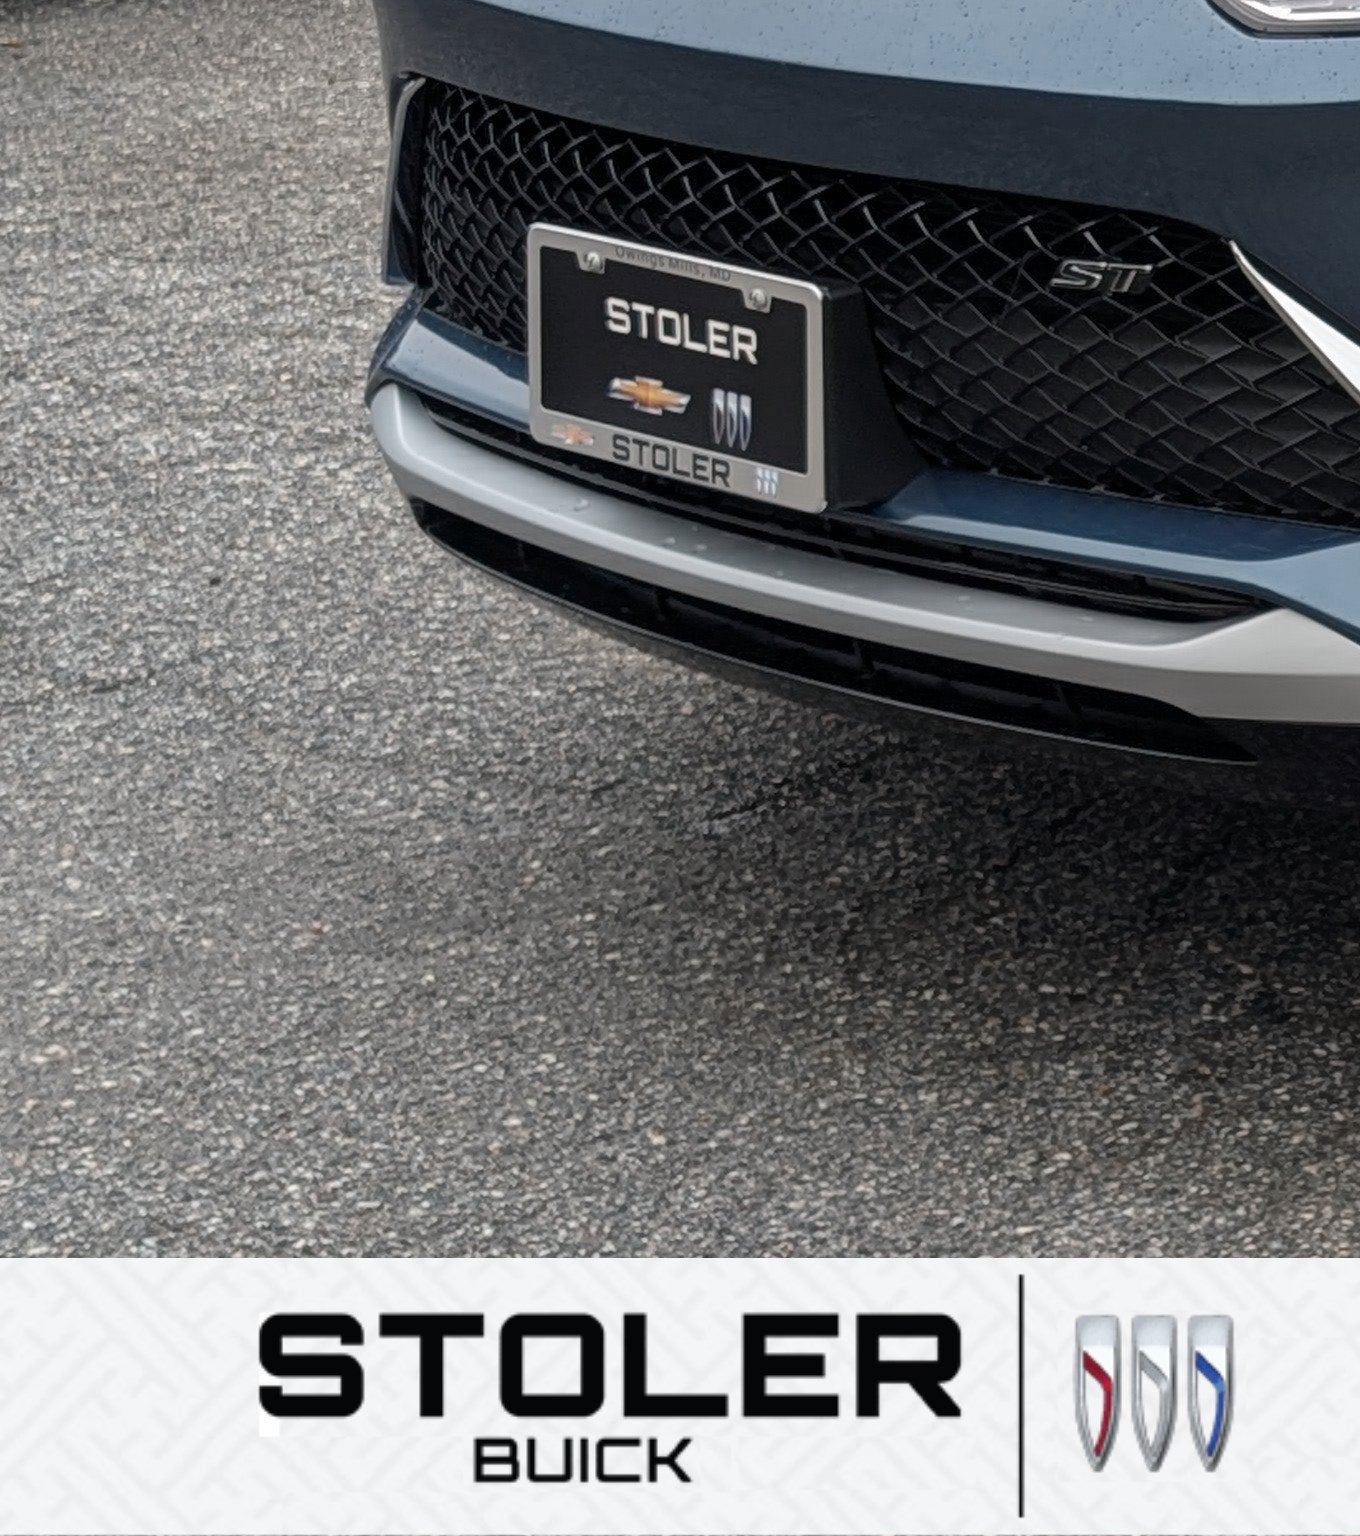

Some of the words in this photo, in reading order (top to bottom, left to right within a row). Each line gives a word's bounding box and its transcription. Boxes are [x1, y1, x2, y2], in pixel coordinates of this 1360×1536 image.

[615, 246, 665, 268] Owings
[709, 266, 731, 282] MD
[1050, 260, 1153, 294] ST
[605, 296, 758, 365] STOLER
[612, 433, 731, 488] STOLER
